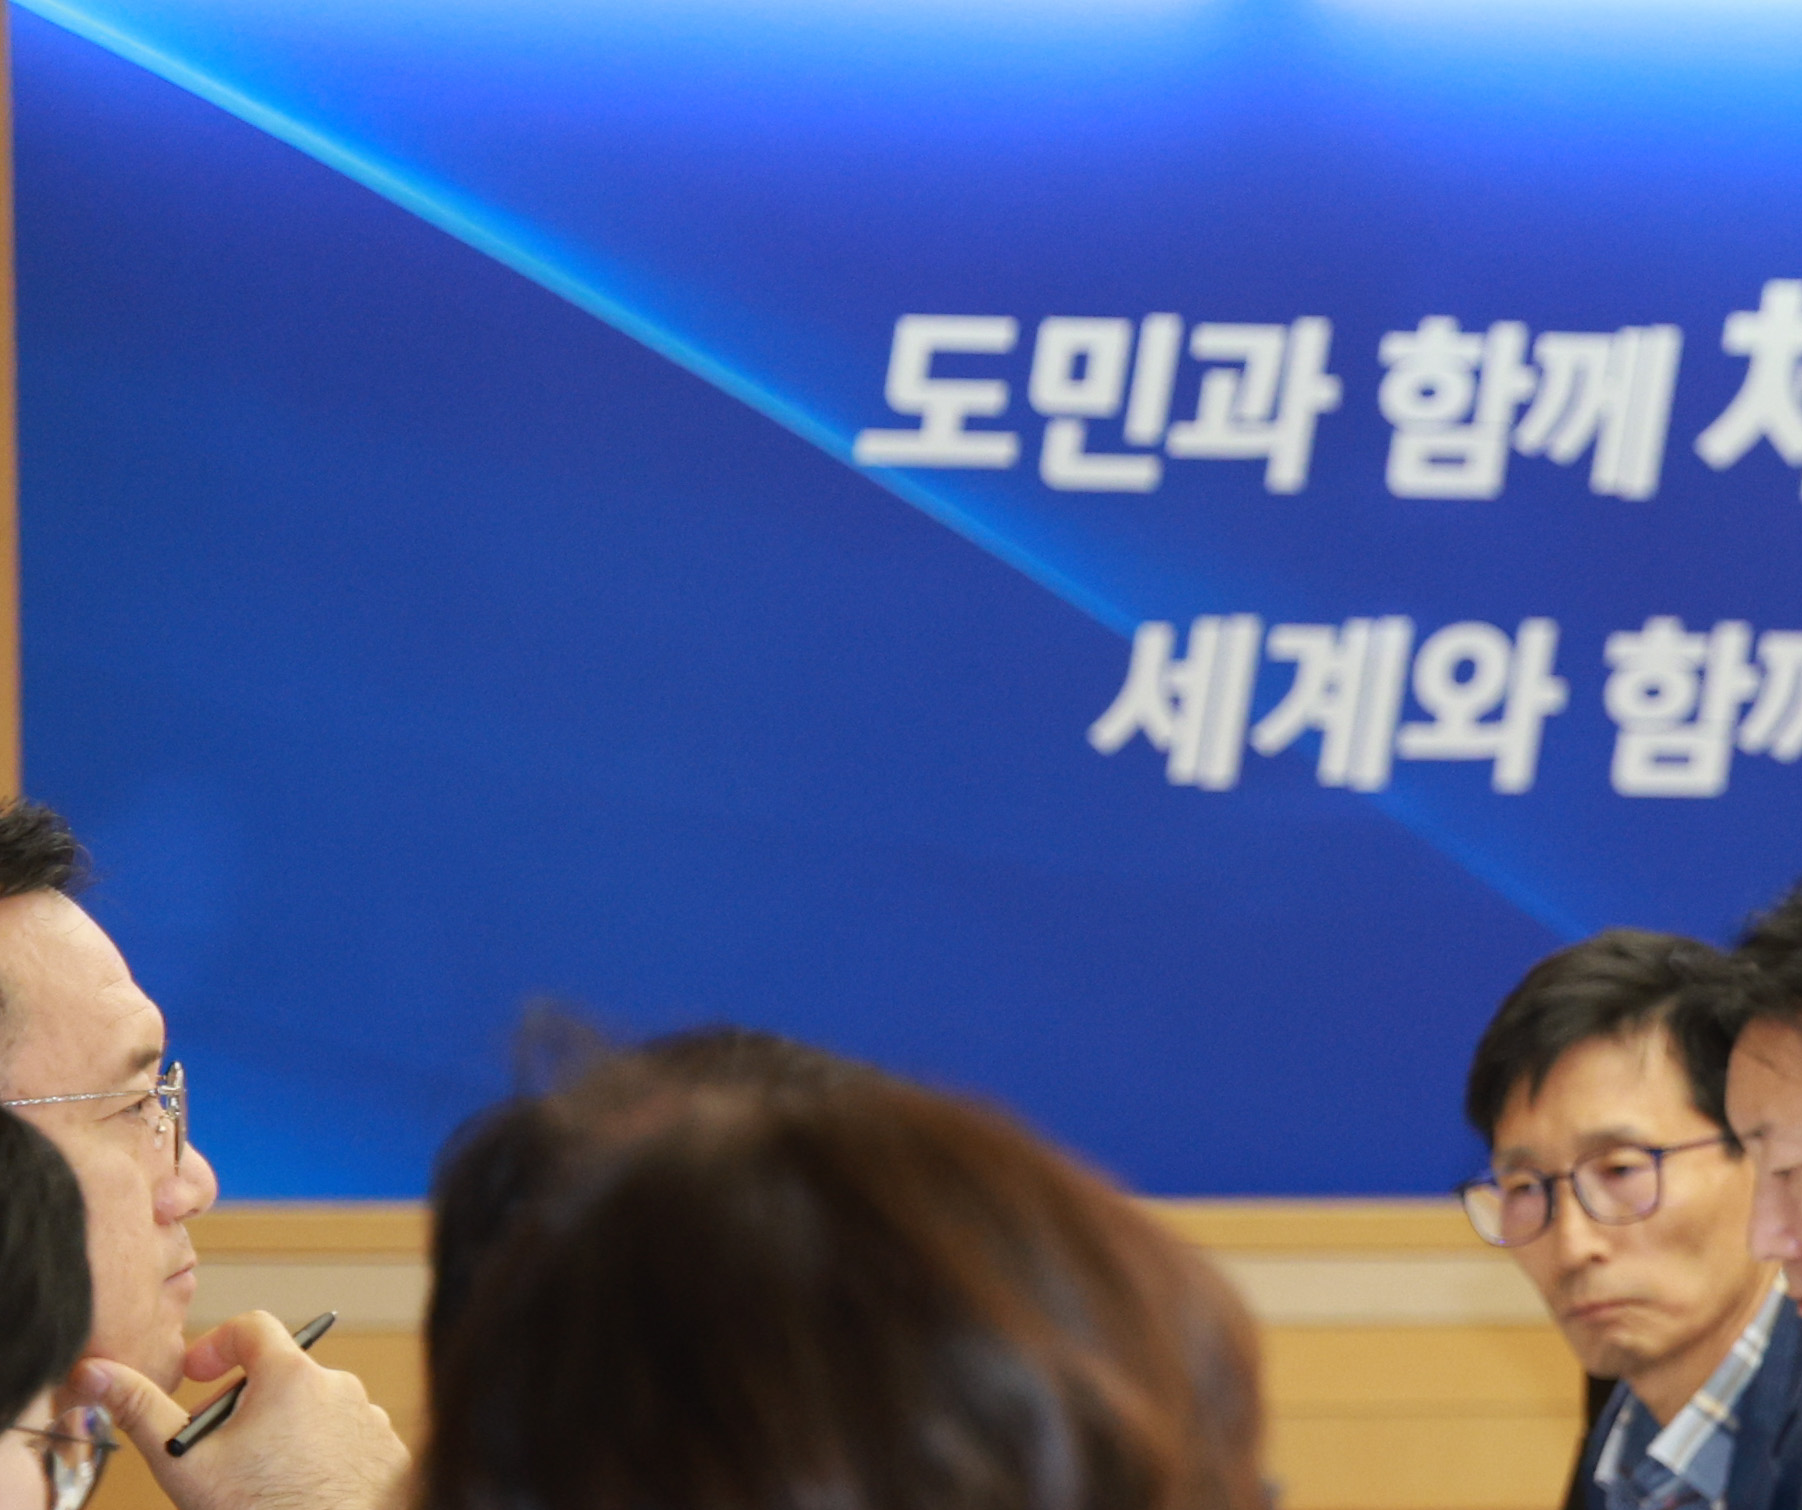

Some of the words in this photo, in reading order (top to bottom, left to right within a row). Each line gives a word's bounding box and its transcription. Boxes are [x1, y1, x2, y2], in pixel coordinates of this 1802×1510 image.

[854, 312, 1341, 493] 도민과
[1378, 315, 1682, 500] 함께
[1091, 613, 1566, 793] 세계와
